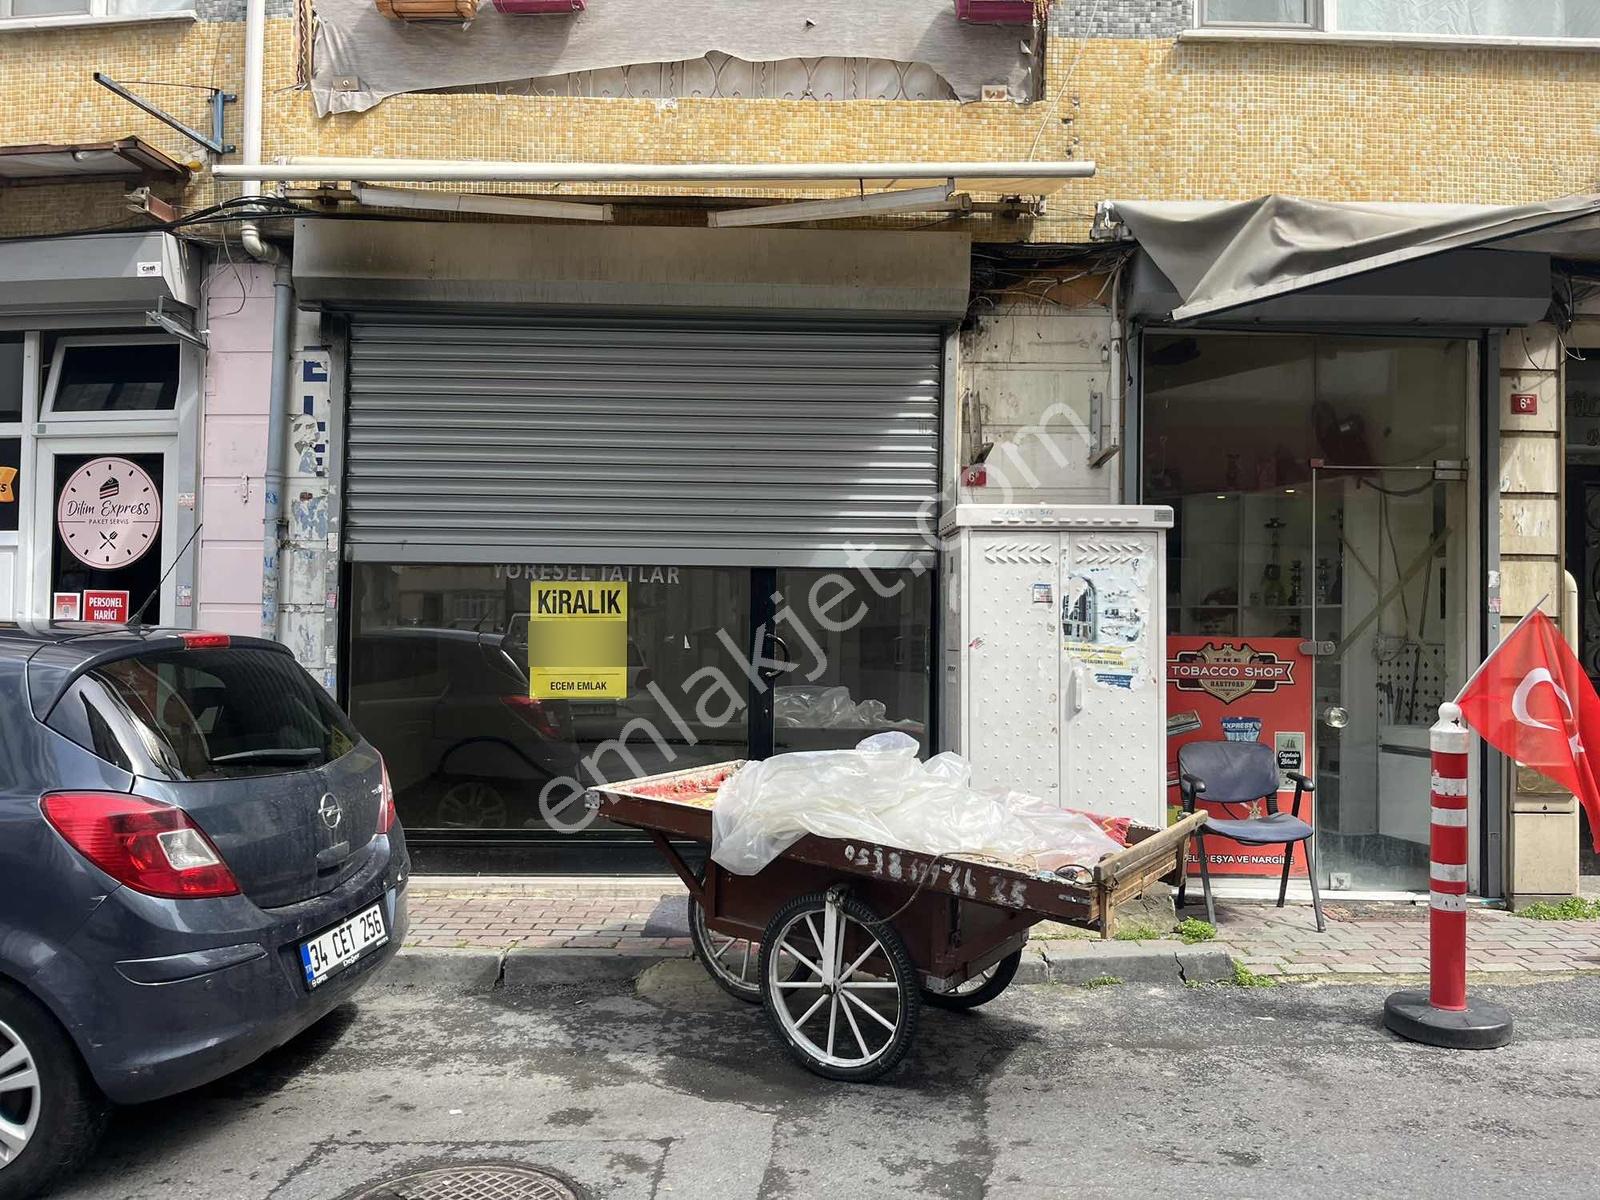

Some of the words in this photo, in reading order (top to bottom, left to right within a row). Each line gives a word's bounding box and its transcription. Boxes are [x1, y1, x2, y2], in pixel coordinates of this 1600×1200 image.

[66, 499, 95, 517] Dilim
[100, 499, 151, 517] Express
[599, 566, 681, 584] TATLAR
[88, 596, 123, 608] PERSONEL
[93, 607, 118, 621] HARİCİ
[1172, 665, 1239, 677] TOBACCO
[1244, 667, 1284, 678] SHOP
[550, 681, 575, 691] ECEM
[576, 681, 607, 691] EMLAK
[1210, 854, 1236, 865] EŞYA
[1237, 855, 1250, 864] VE
[310, 940, 329, 972] 34
[332, 924, 355, 958] CET
[360, 910, 382, 942] 256
